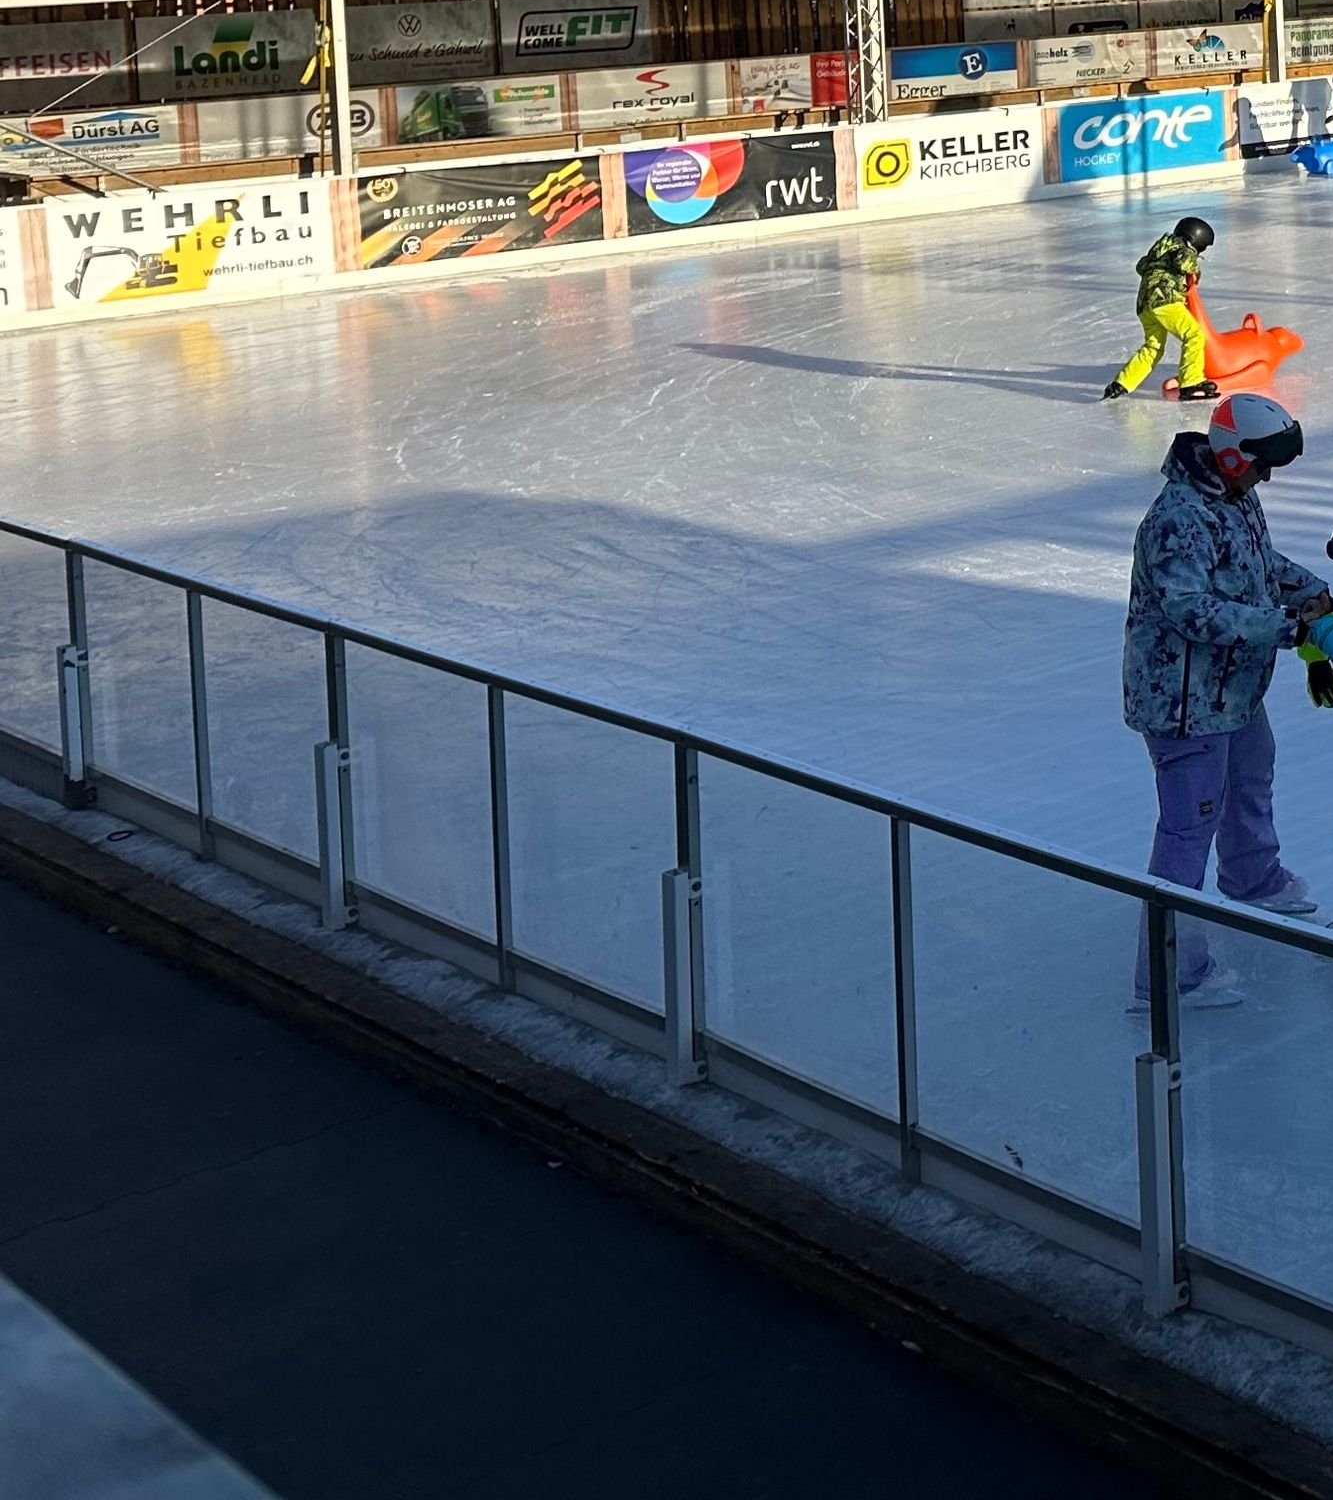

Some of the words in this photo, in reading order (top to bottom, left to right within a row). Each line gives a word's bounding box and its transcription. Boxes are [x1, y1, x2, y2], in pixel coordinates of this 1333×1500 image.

[525, 24, 564, 38] WELL
[566, 13, 630, 47] FIT
[524, 37, 563, 50] COME
[174, 40, 279, 76] Landi
[1174, 49, 1247, 66] KELLER
[175, 73, 281, 91] BAZENHEID
[613, 99, 644, 109] rex
[650, 92, 694, 107] royal
[72, 119, 124, 139] Dürst
[130, 119, 160, 137] AG
[1073, 104, 1213, 150] conte
[919, 129, 1030, 161] KELLER
[920, 153, 1031, 180] KIRCHBERG
[1074, 153, 1121, 168] HOCKEY
[765, 167, 823, 208] rwt
[64, 191, 309, 238] WEHRLI
[383, 198, 493, 220] BREITENMOSER
[497, 196, 516, 207] AG
[437, 212, 517, 228] FARBGESTALTUNG
[167, 226, 312, 253] Tiefbau
[203, 255, 313, 277] wehrli-tiefbau.ch
